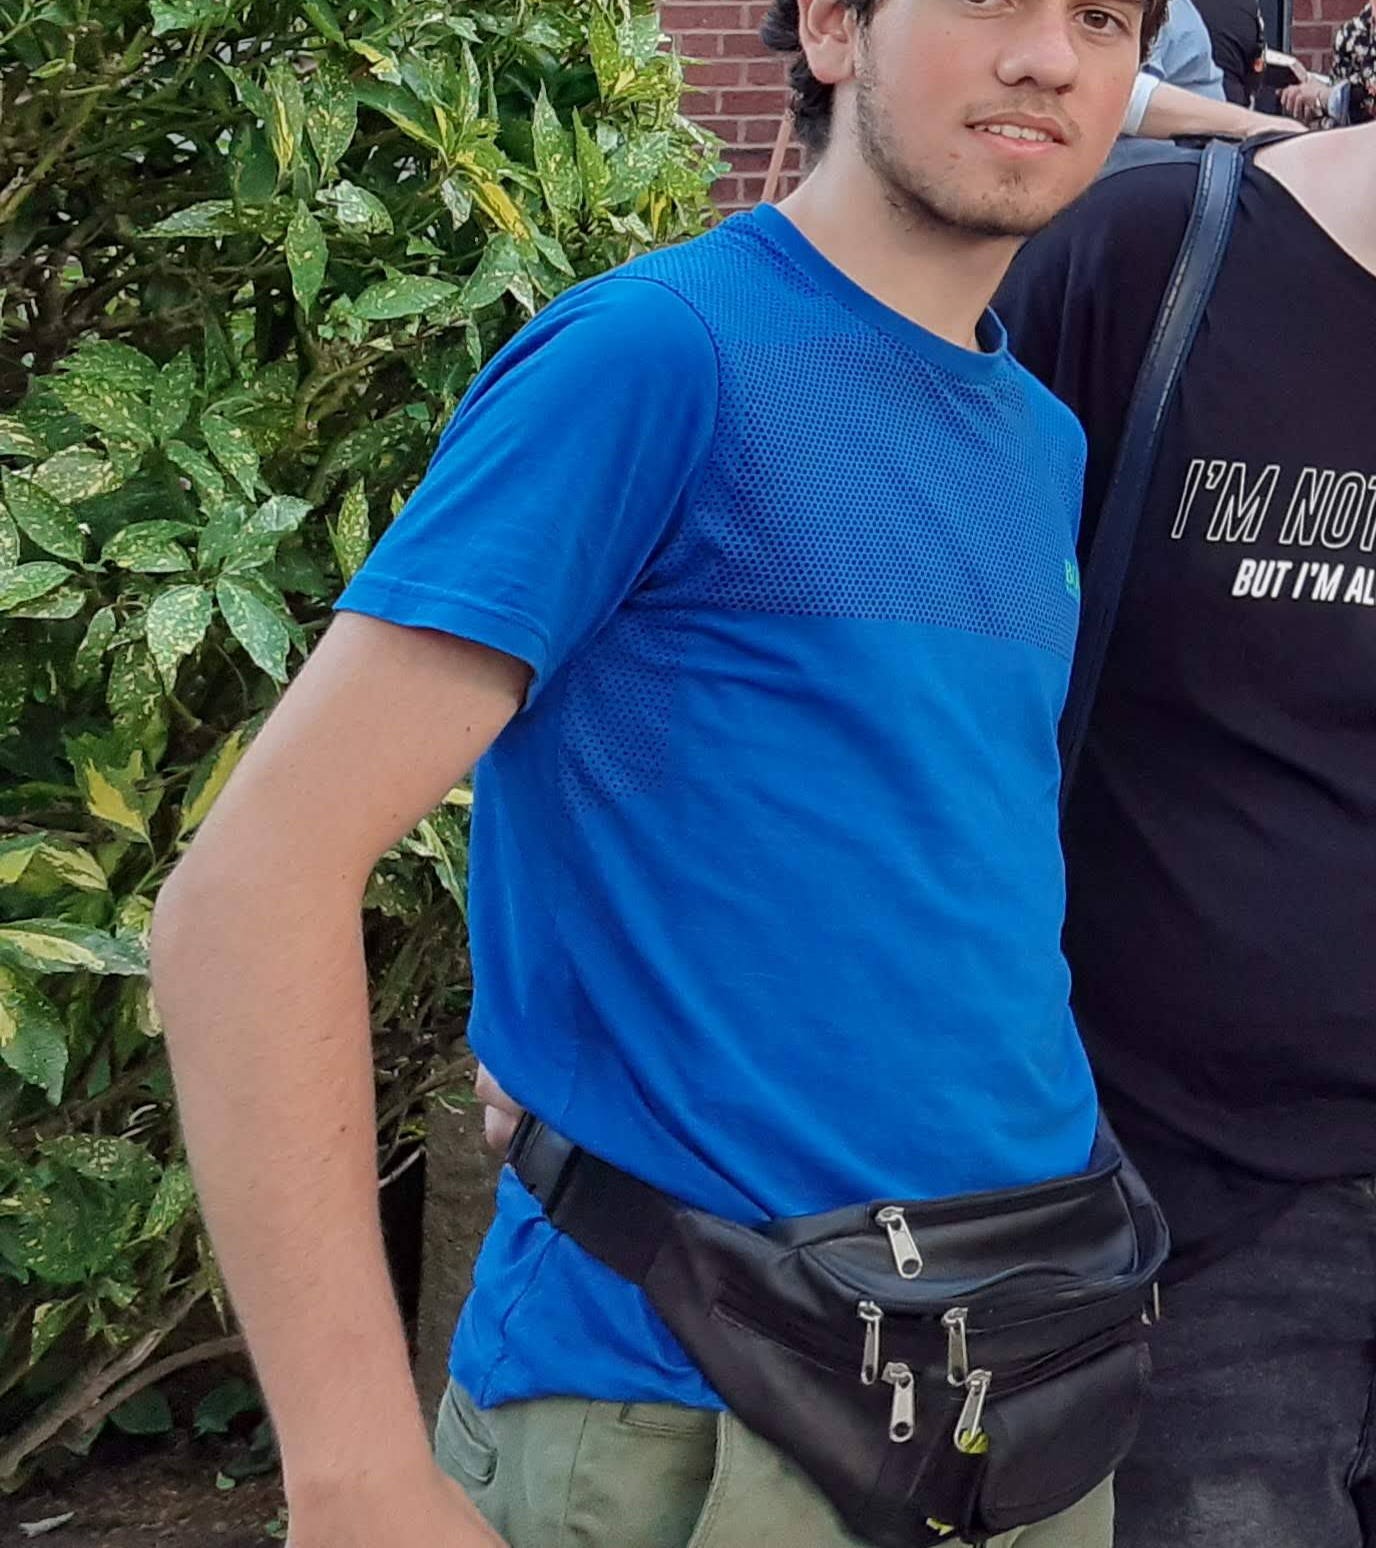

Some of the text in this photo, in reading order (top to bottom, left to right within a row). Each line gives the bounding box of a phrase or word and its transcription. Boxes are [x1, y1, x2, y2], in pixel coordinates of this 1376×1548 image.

[1170, 459, 1281, 543] I'M
[1231, 558, 1294, 599] BUT
[1291, 561, 1345, 602] I'M
